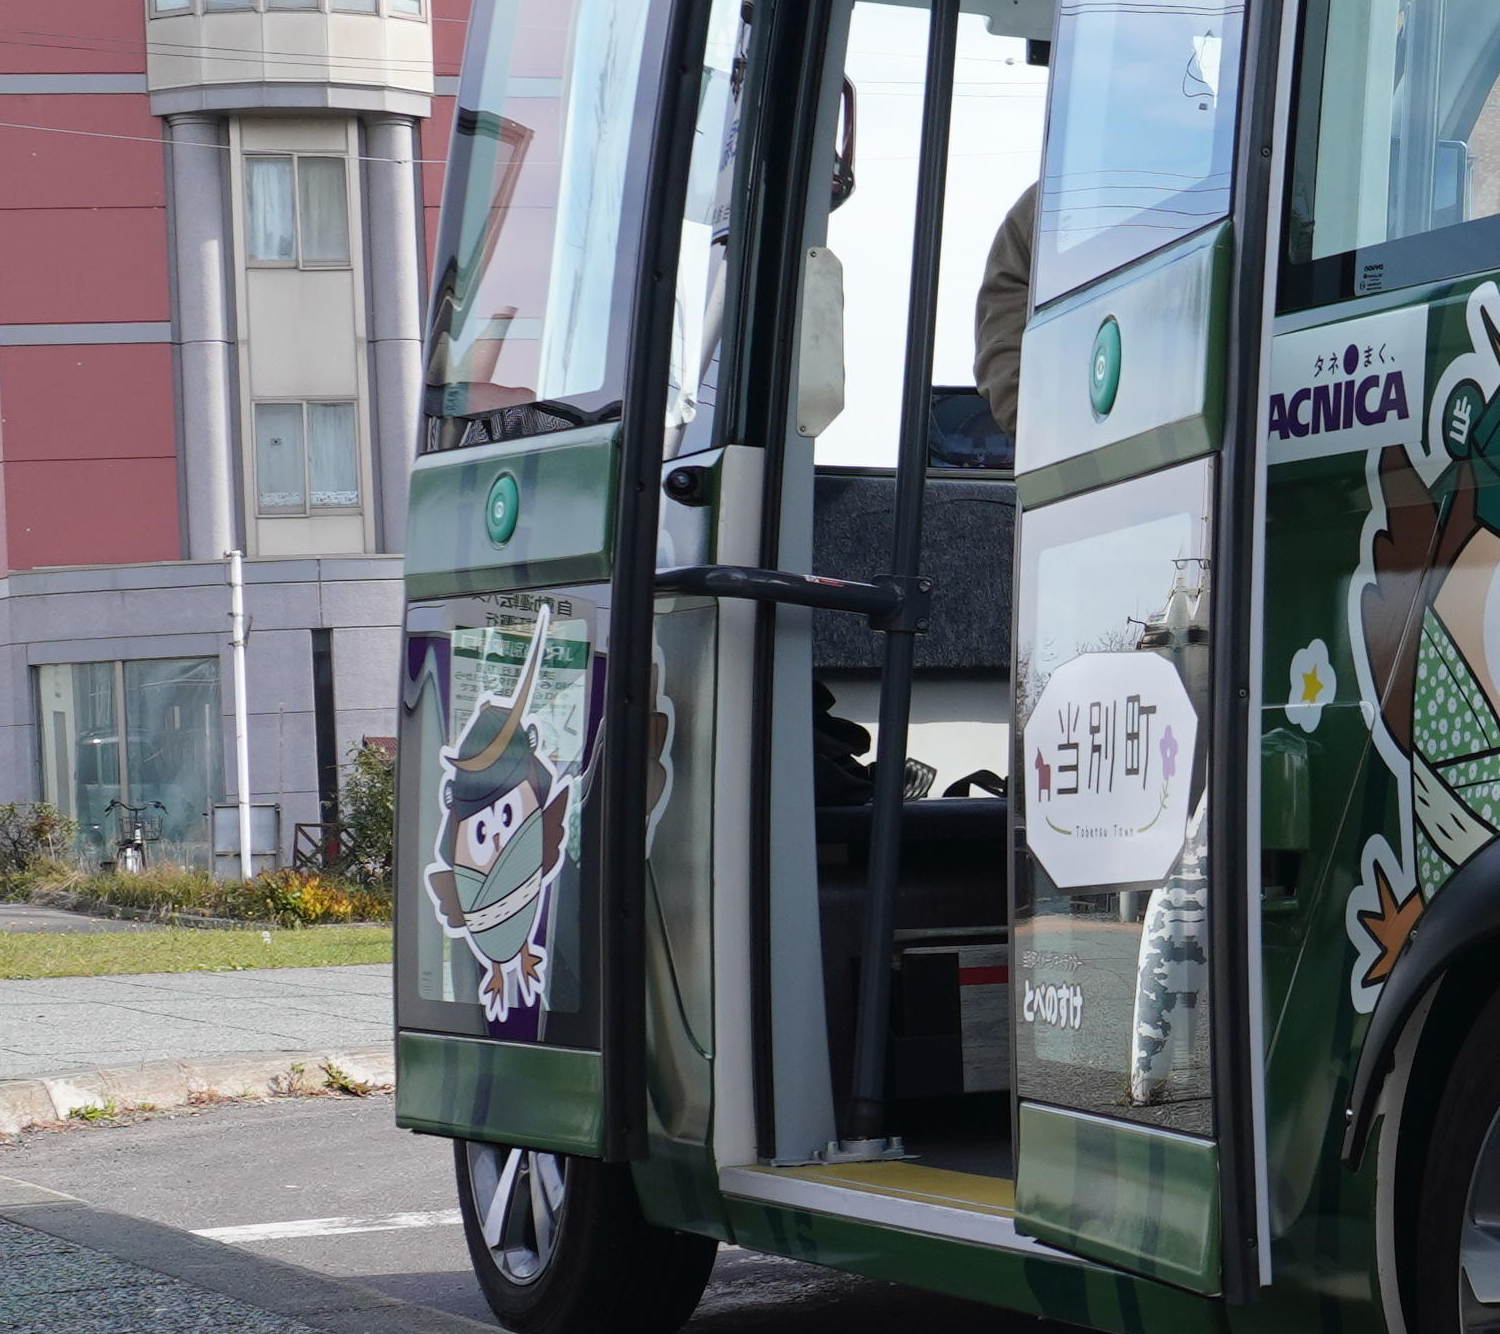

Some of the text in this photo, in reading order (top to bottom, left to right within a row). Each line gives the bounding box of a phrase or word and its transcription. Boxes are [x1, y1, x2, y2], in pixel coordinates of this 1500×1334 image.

[1268, 370, 1410, 442] ACNICA
[1057, 694, 1157, 795] 当別町
[1023, 979, 1084, 1030] とべのすけ
